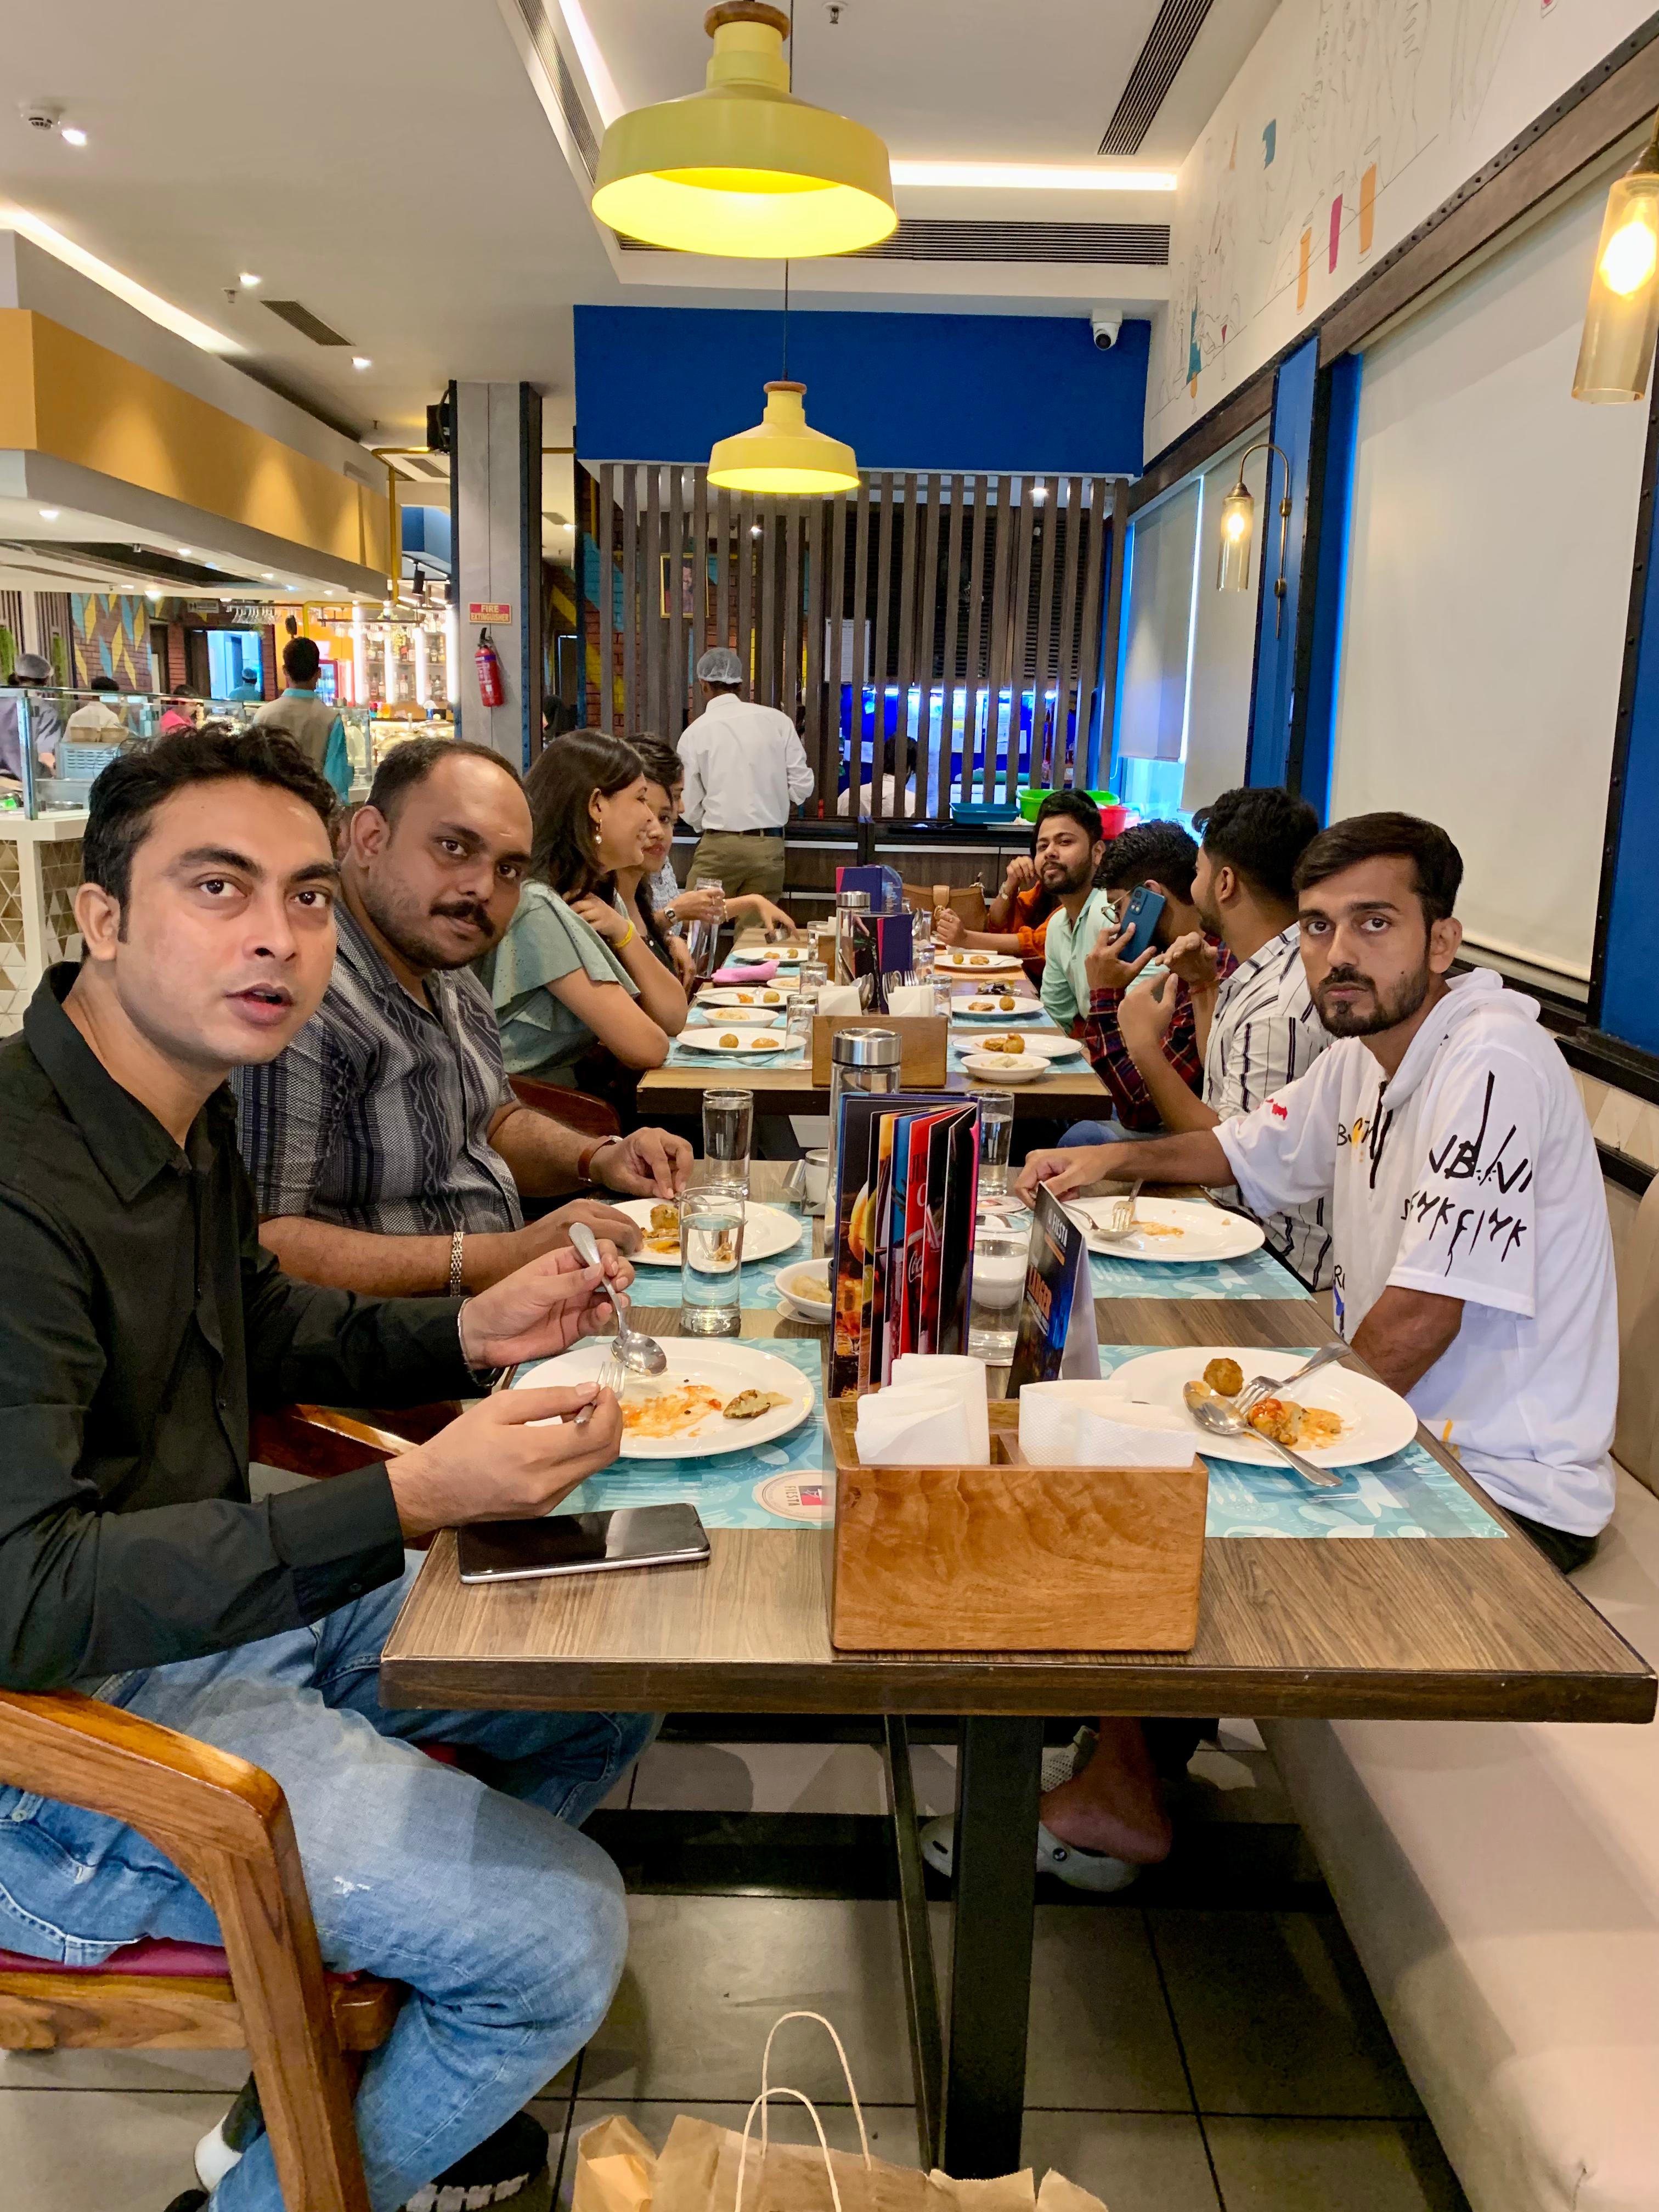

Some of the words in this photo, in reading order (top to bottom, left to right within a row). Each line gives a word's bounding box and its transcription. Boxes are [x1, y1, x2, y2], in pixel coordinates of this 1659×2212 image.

[481, 605, 499, 613] FIRE
[471, 613, 509, 621] EXTINGUISHER
[1052, 1213, 1068, 1248] FIESTA
[783, 1486, 800, 1506] FIESTA
